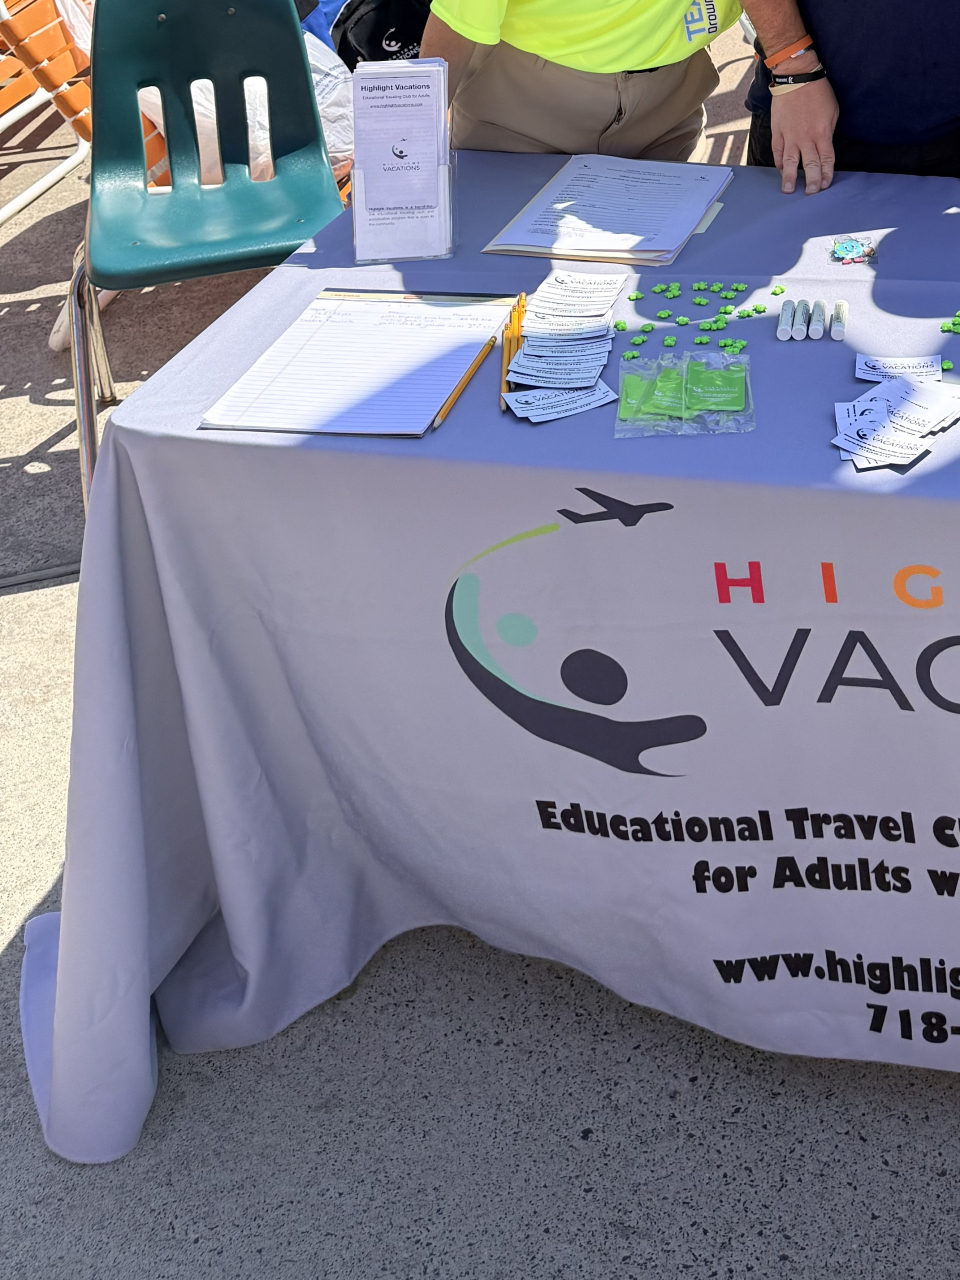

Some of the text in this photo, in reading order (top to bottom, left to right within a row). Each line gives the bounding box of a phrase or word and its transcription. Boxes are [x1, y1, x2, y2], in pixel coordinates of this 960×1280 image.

[360, 83, 431, 93] Highlight Vacations
[534, 388, 584, 402] VACATION
[872, 435, 920, 451] VACATIONS
[536, 800, 774, 844] Educational
[785, 808, 916, 844] Travel
[692, 860, 758, 894] for
[773, 856, 912, 894] Adults
